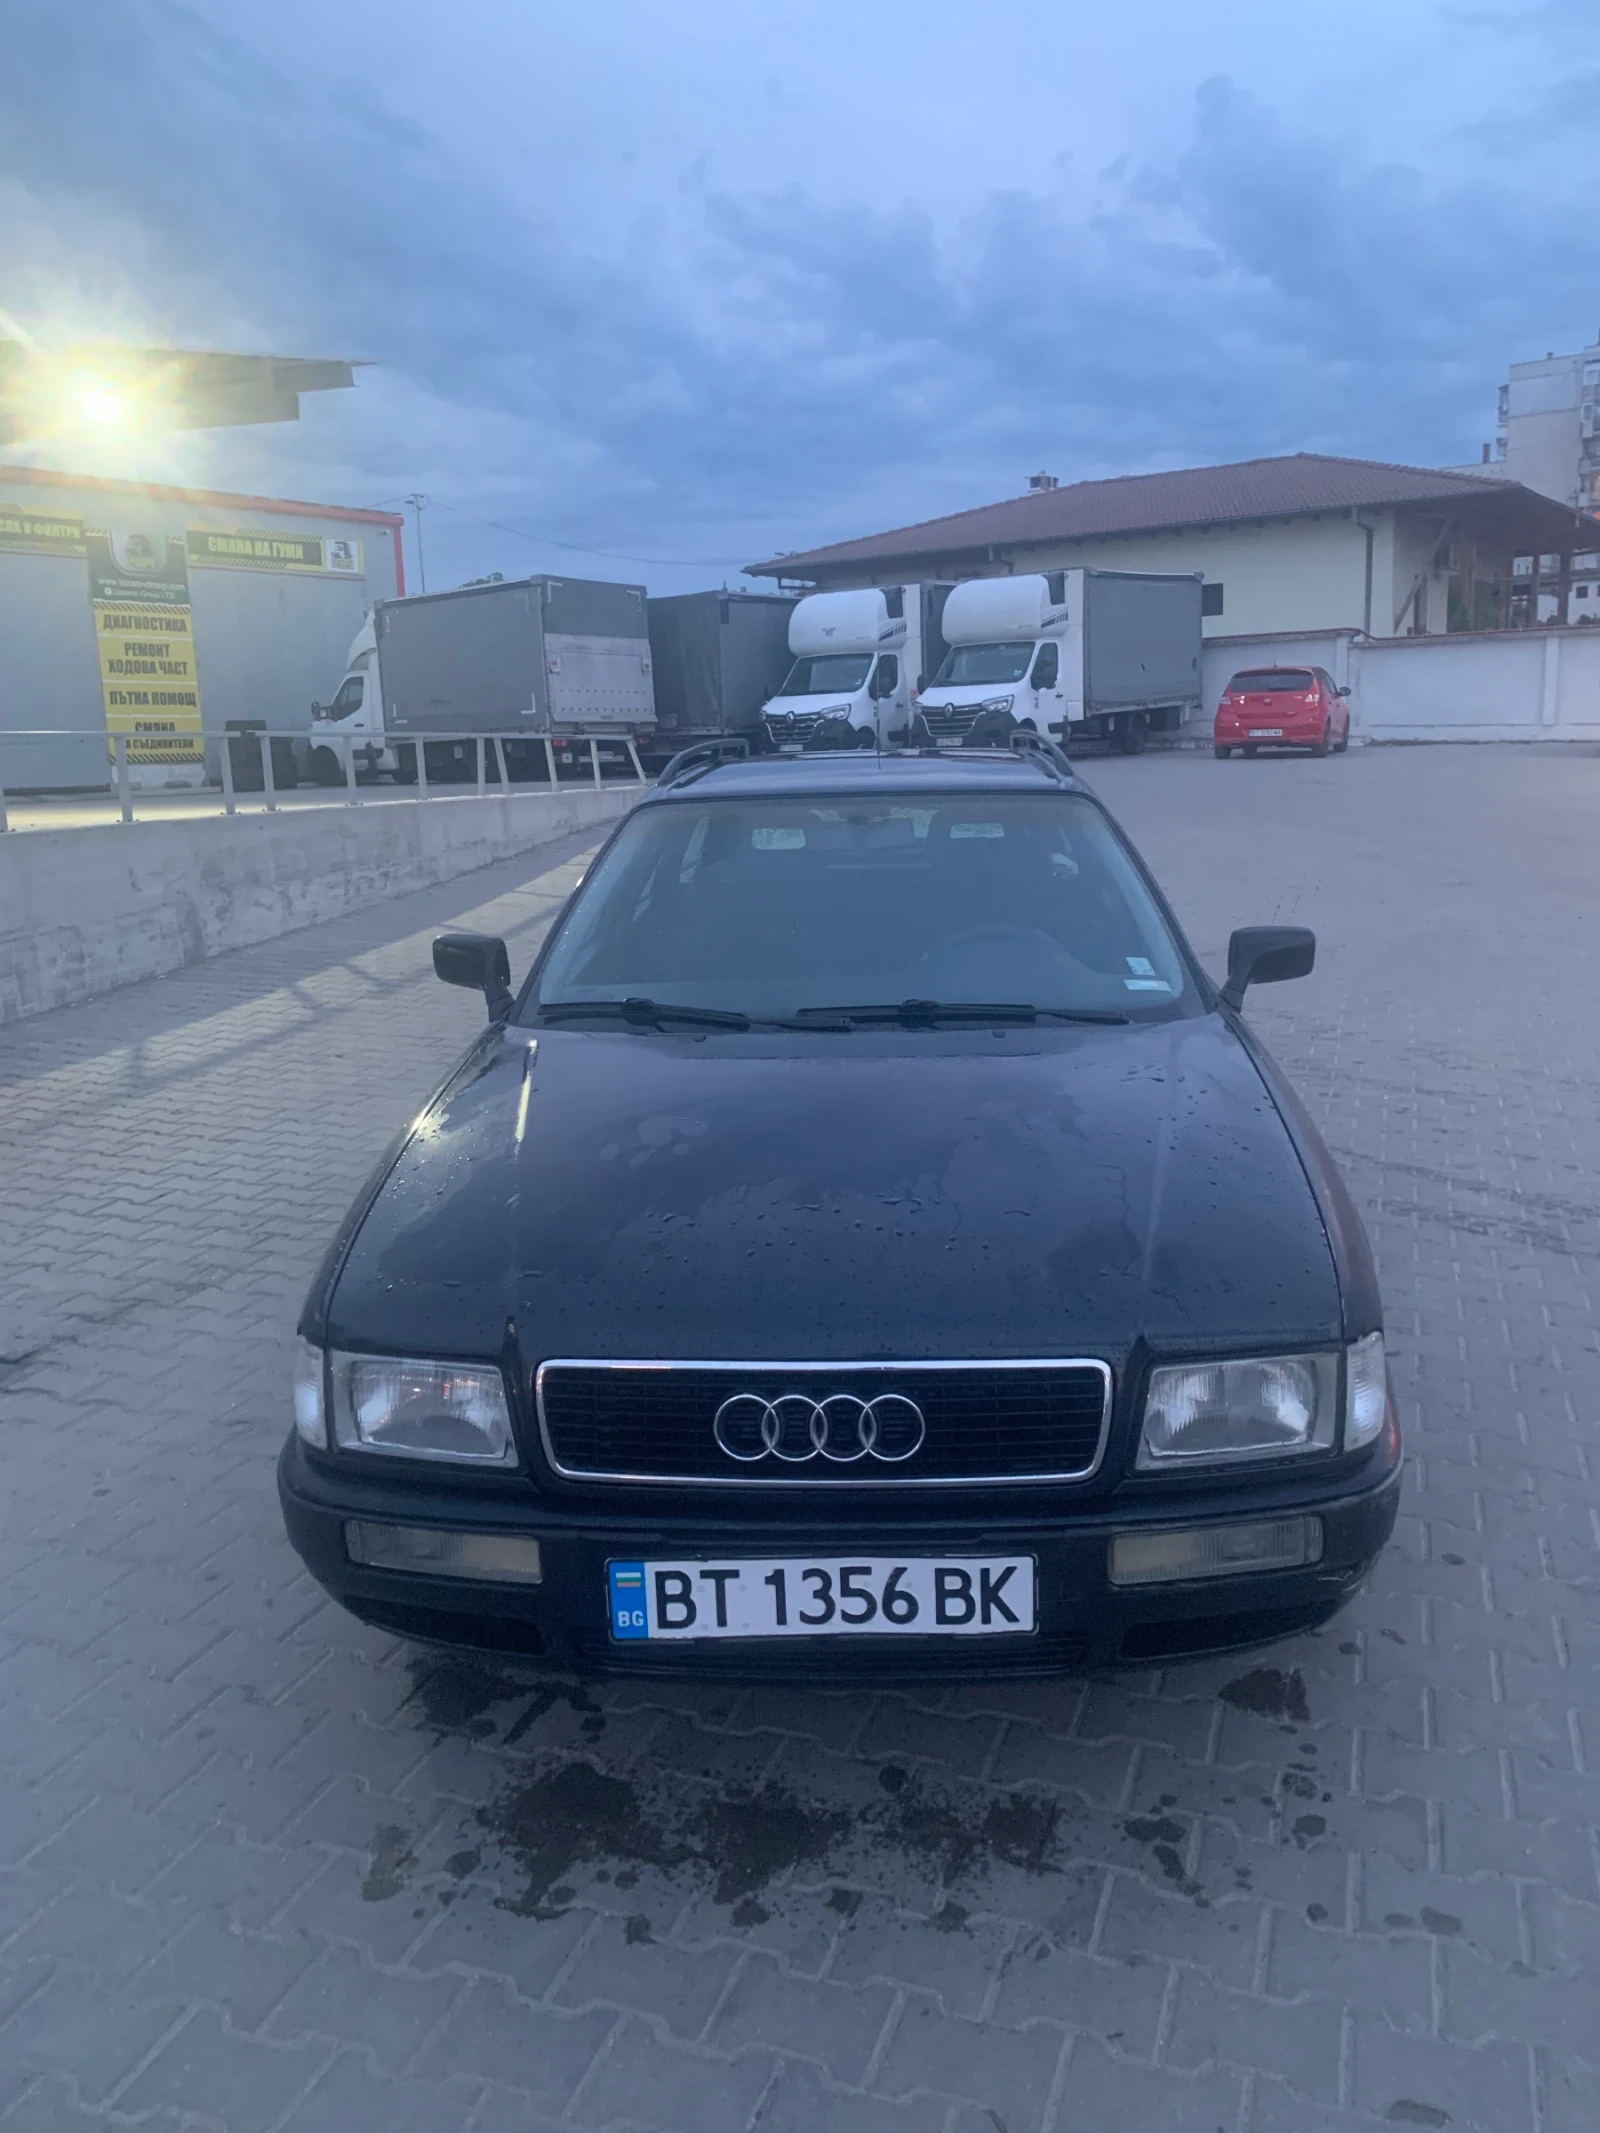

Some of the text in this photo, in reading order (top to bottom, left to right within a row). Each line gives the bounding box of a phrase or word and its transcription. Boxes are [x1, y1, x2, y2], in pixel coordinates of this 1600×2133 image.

[207, 535, 304, 560] СМЯНА НА ГУМИ
[161, 591, 175, 600] LTD
[103, 614, 187, 632] ДИАГНОСТИКА
[124, 641, 171, 658] РЕМОНТ
[107, 659, 188, 676] ХОДОВА ЧАСТ
[109, 690, 197, 708] ПЪТНА ПОМОЩ
[134, 721, 176, 732] СМЯНА
[132, 738, 194, 750] СЪЕДИНИТЕЛИ
[655, 1566, 1020, 1630] BT 1356 BK
[618, 1610, 645, 1627] BG
